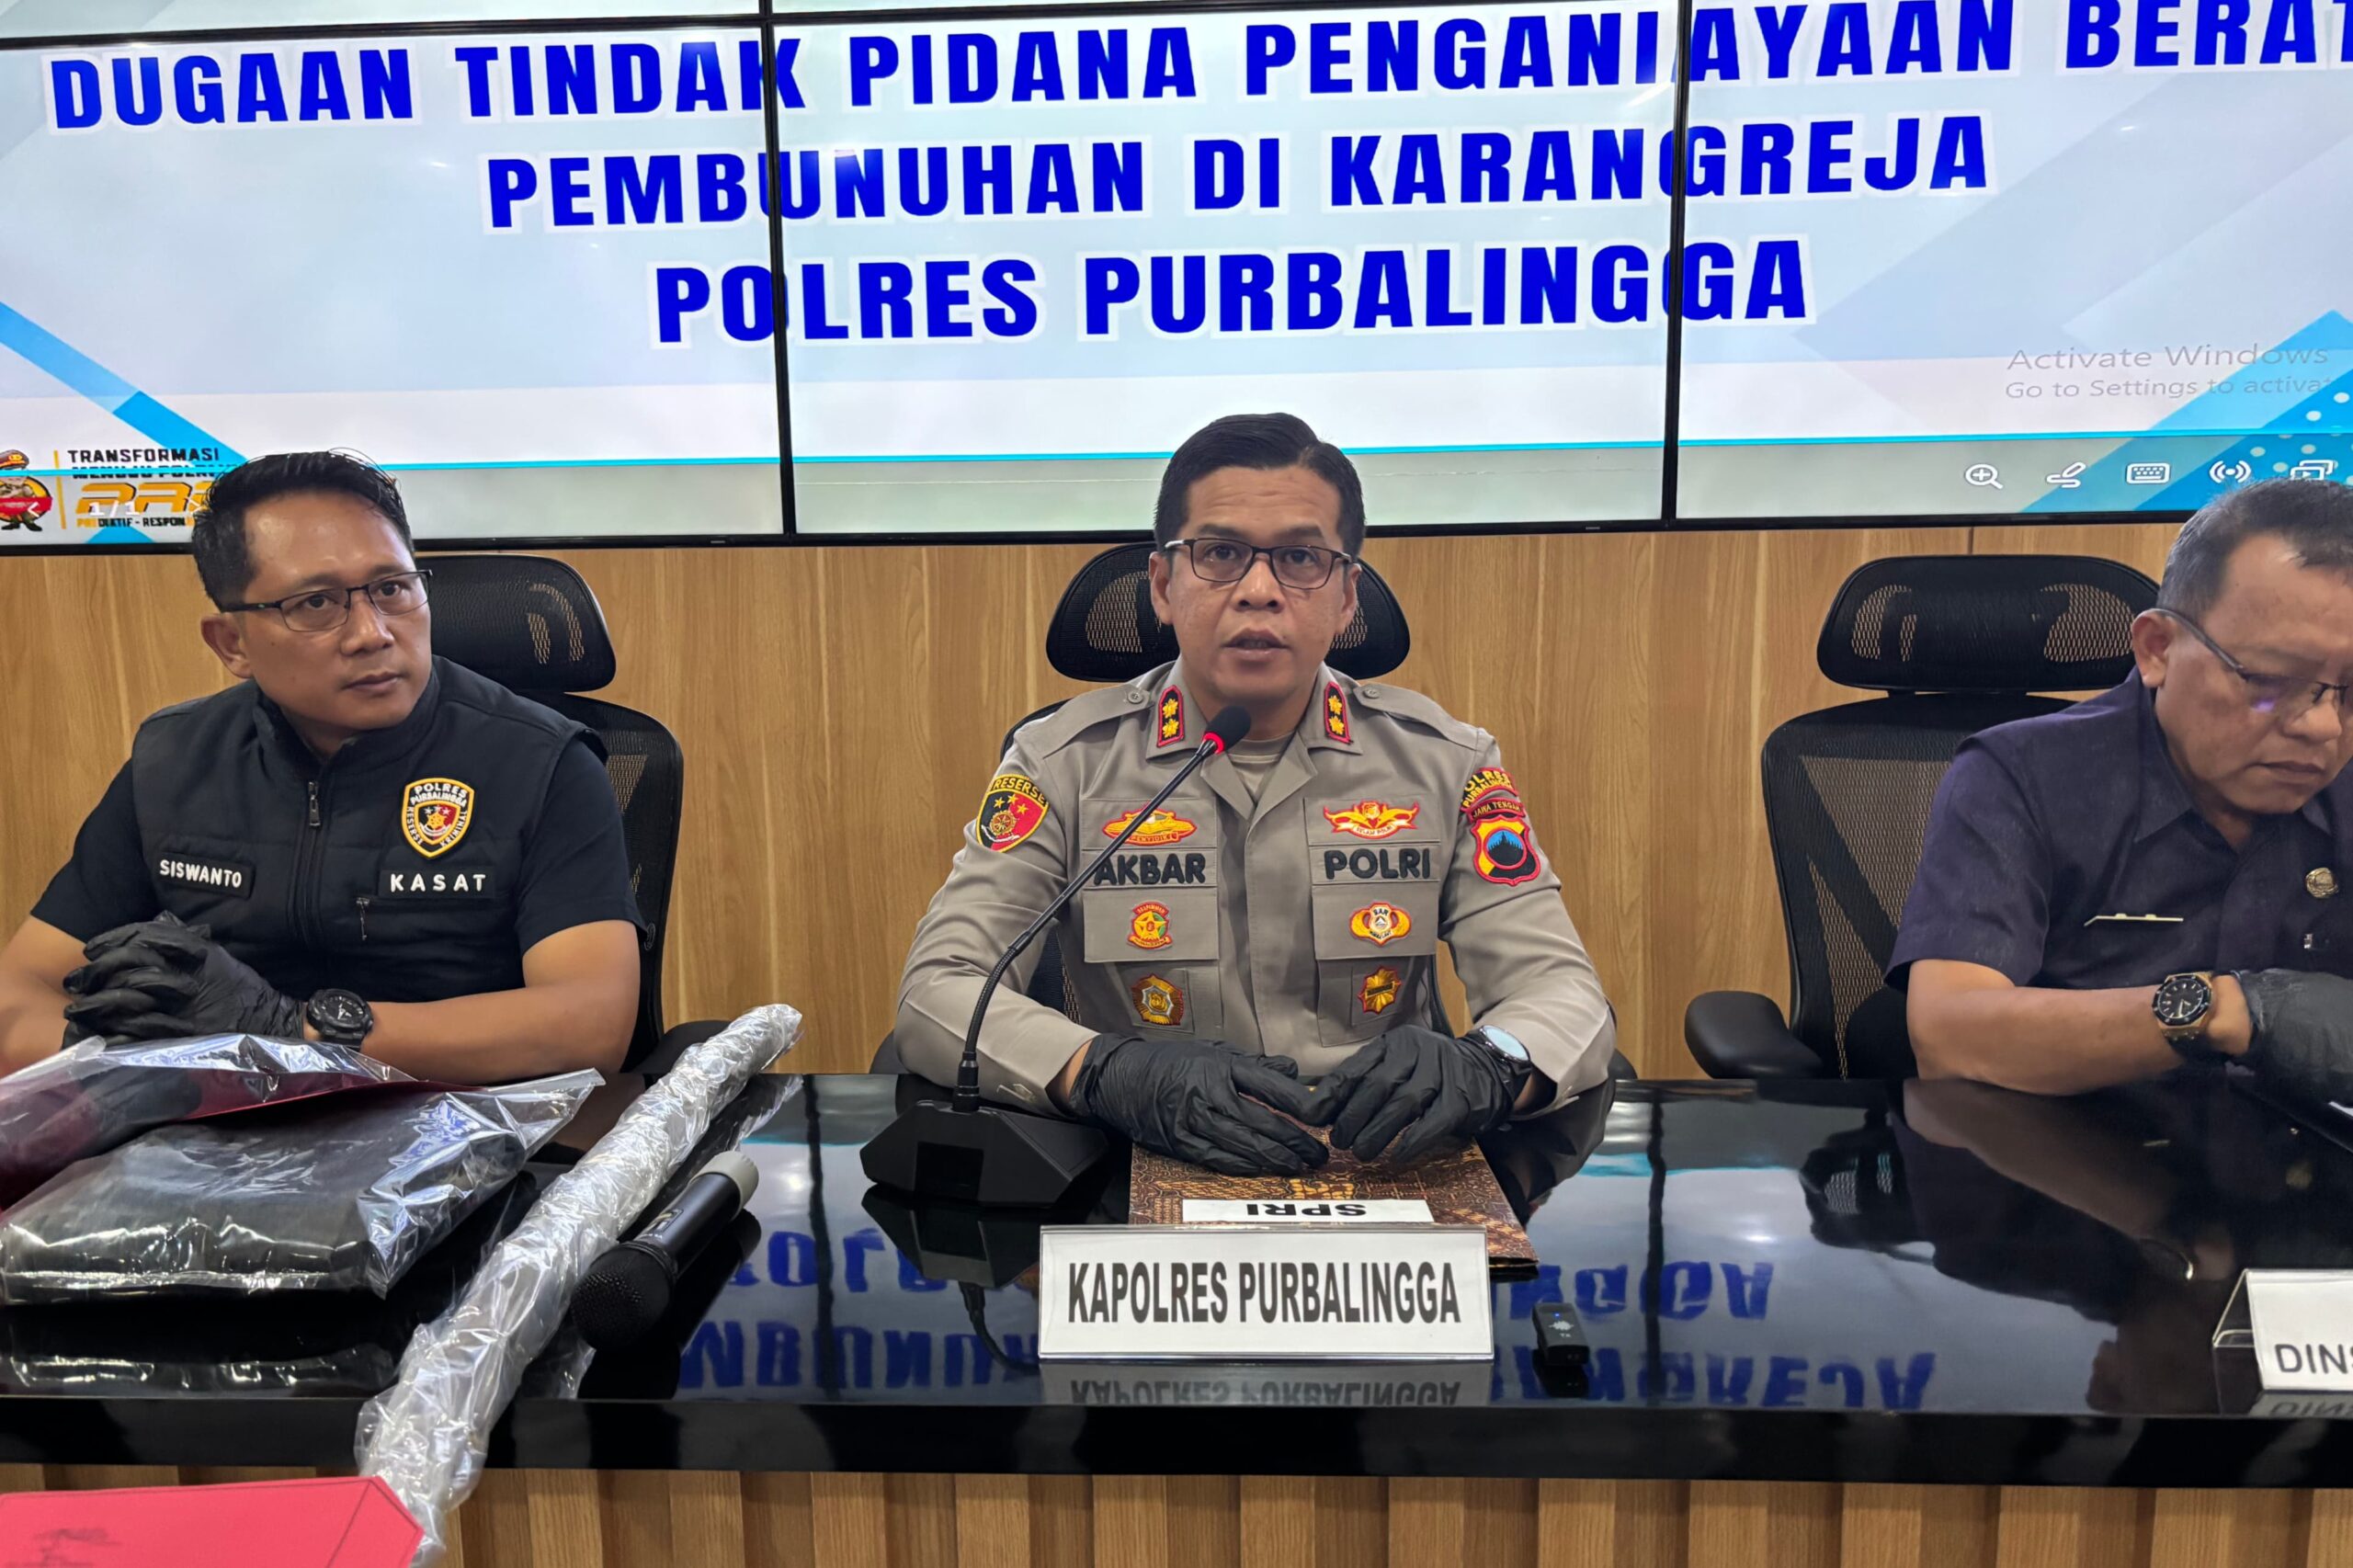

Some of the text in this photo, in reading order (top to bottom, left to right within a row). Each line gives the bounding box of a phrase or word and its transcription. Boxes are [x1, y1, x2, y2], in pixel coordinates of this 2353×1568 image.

[51, 50, 412, 128] DUGAAN
[455, 39, 804, 116] TINDAK
[850, 28, 1196, 106] PIDANA
[1247, 0, 2012, 95] PENGANIAYAAN
[489, 117, 1985, 227] PEMBUNUHAN DI KARANGREJA
[657, 241, 1804, 342] POLRES PURBALINGGA
[2007, 343, 2329, 369] Activate Windows
[2006, 381, 2042, 398] Go
[2053, 381, 2080, 397] to
[2090, 378, 2198, 399] Settings
[2209, 377, 2234, 393] to
[68, 448, 219, 463] TRANSFORMASI
[414, 782, 468, 799] POLRES
[1463, 770, 1511, 792] OLRES
[160, 859, 242, 889] SISWANTO
[1094, 853, 1205, 885] AKBAR
[1324, 848, 1430, 880] POLRI
[390, 873, 486, 892] KASAT
[1246, 1204, 1367, 1217] SPRI
[1068, 1262, 1228, 1324] KAPOLRES
[1240, 1261, 1461, 1324] PURBALINGGA
[2275, 1344, 2353, 1374] DIN
